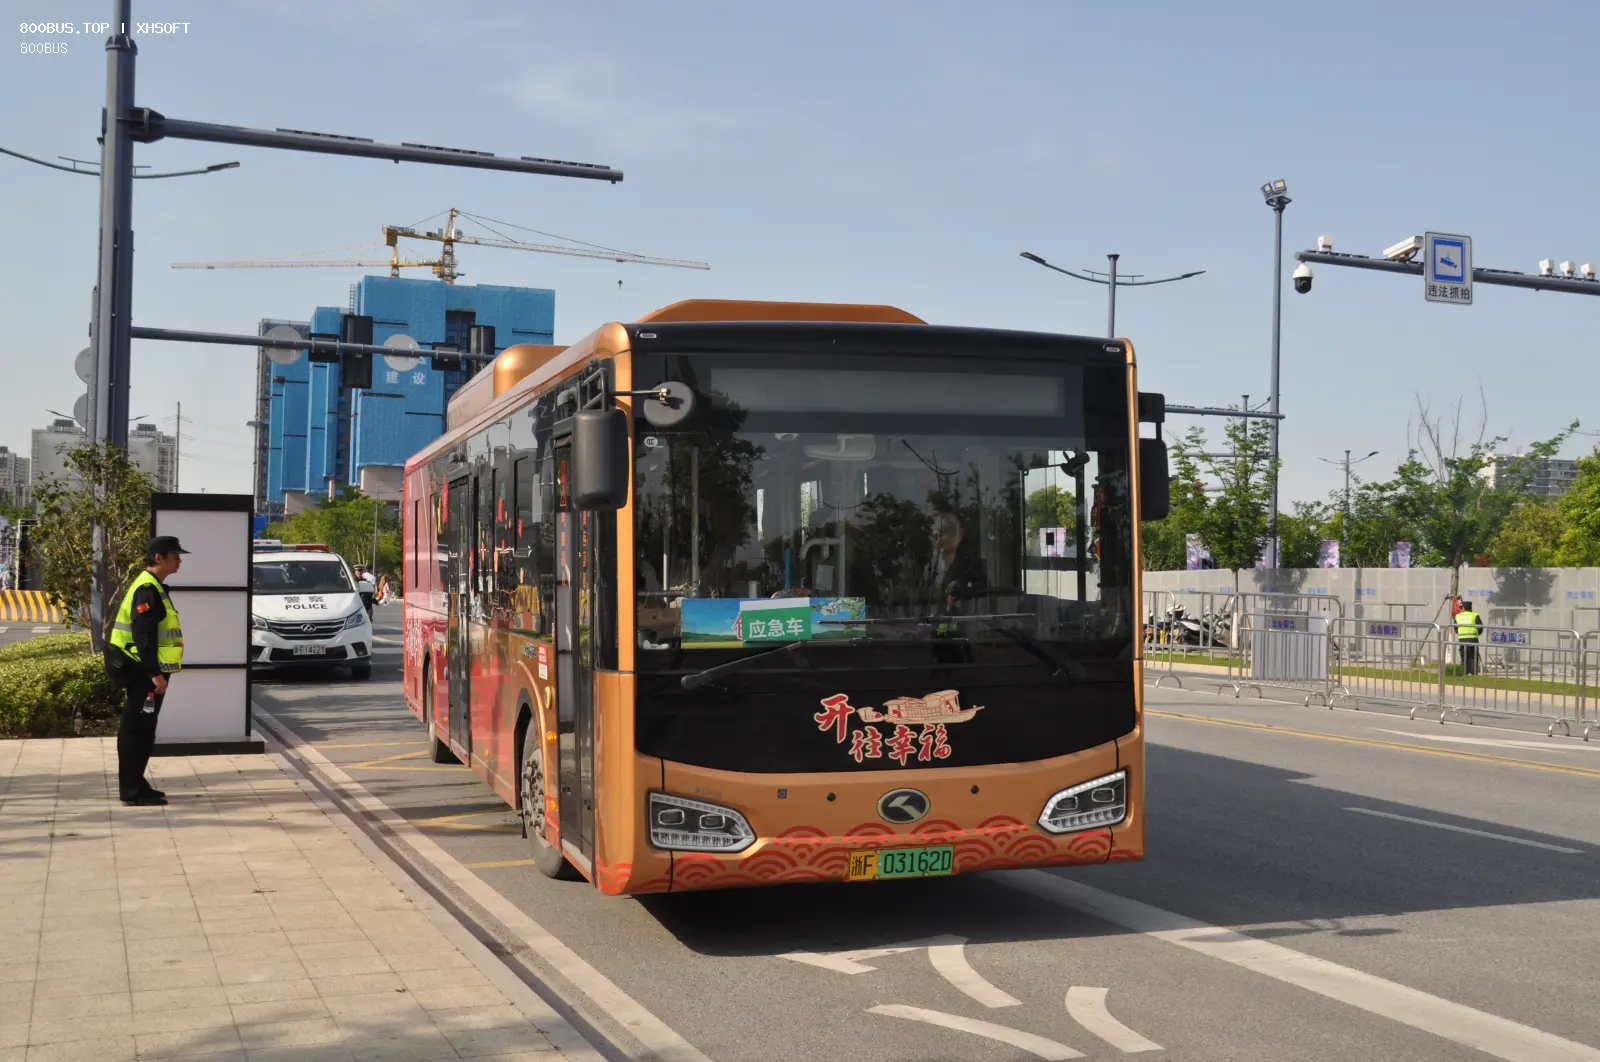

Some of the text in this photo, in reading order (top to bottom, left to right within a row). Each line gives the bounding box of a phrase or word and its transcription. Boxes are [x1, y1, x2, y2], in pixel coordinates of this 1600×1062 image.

[1428, 284, 1470, 300] 违法抓拍
[748, 617, 804, 639] 应急车
[814, 693, 952, 766] 开往幸福
